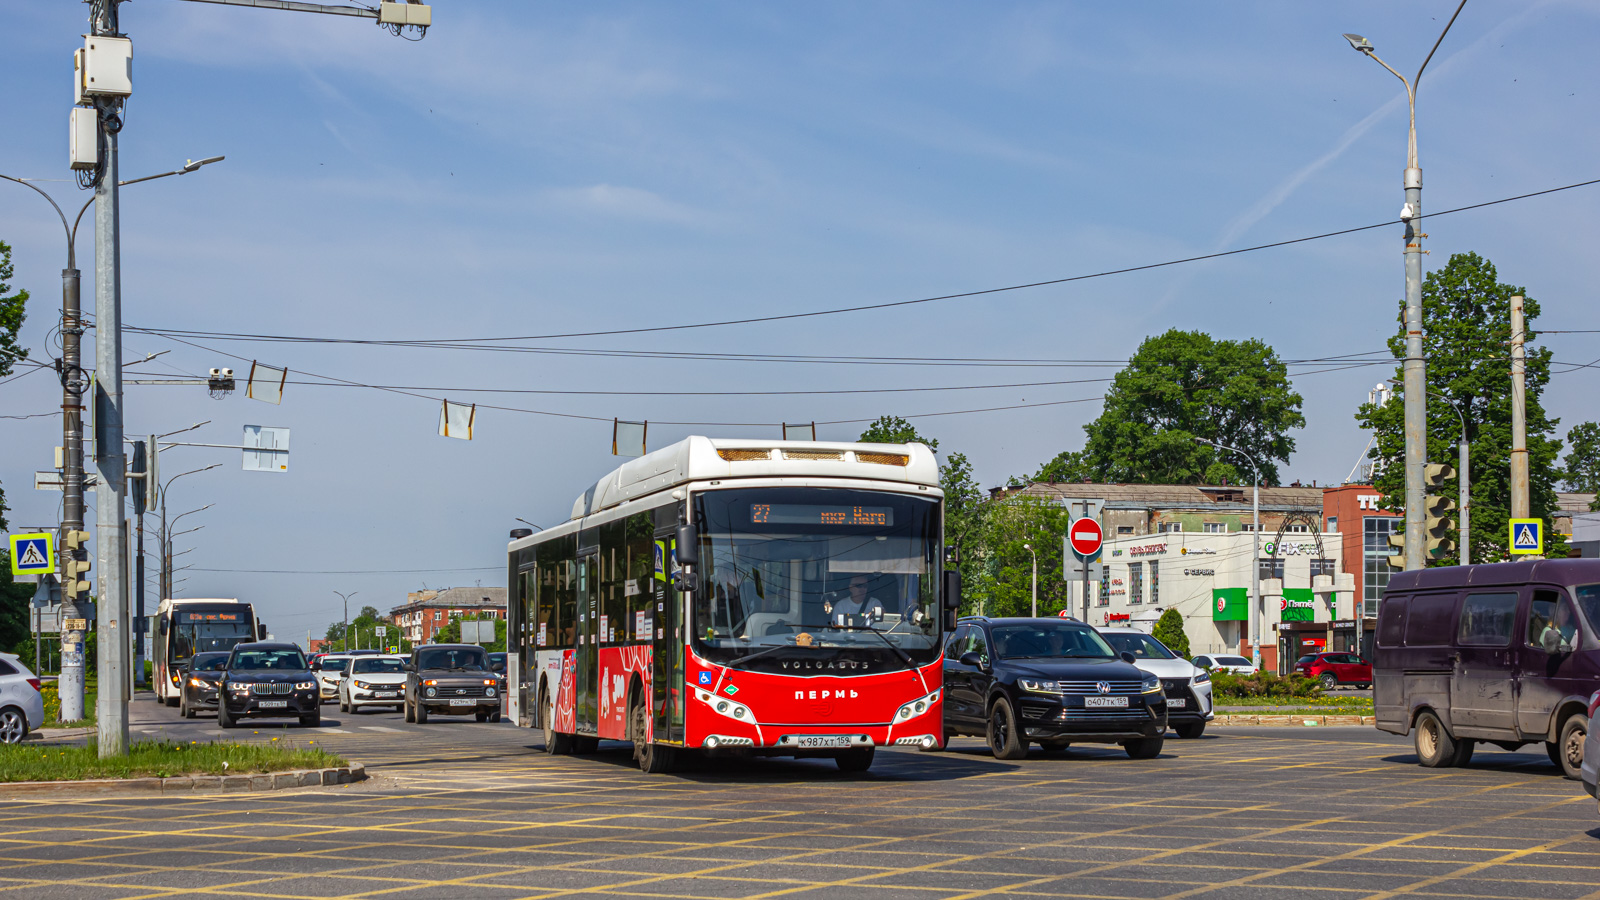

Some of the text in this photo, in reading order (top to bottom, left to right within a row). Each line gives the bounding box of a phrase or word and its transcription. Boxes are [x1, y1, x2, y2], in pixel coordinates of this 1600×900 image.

[753, 504, 770, 523] 27
[782, 661, 869, 670] VOLGABUS
[794, 689, 859, 700] ПЕРМЬ
[800, 736, 850, 748] К987ХТ 159
